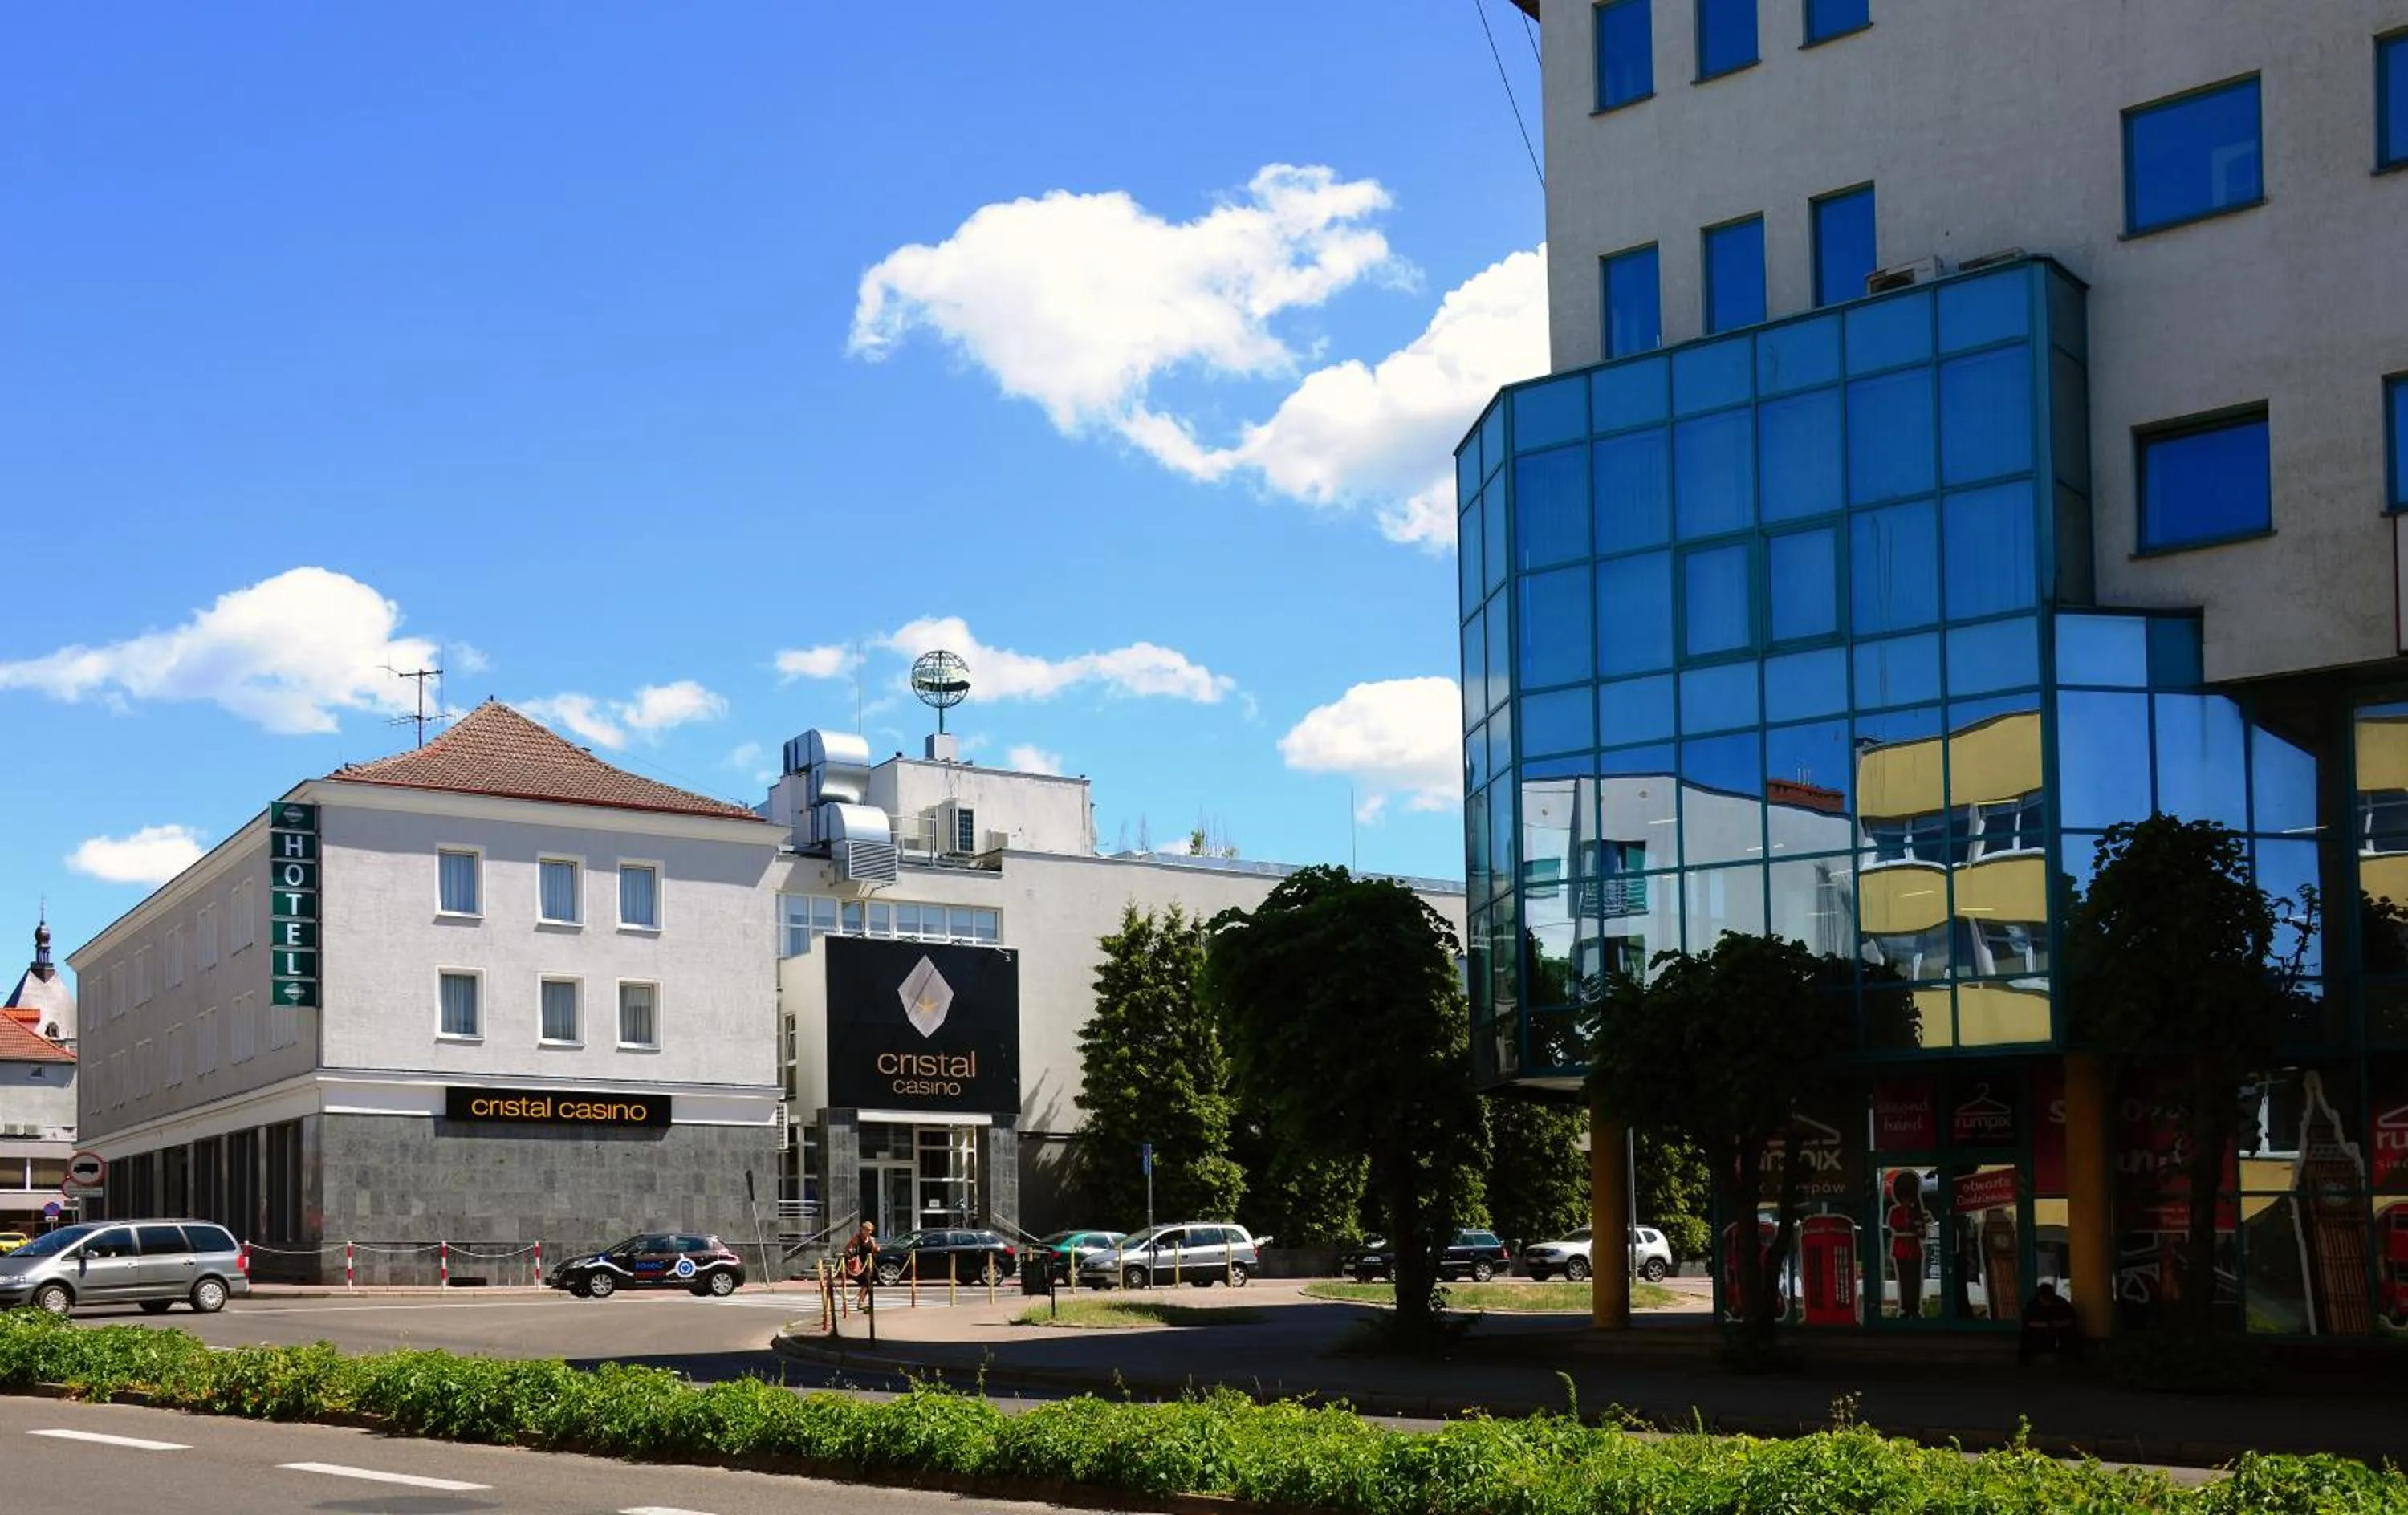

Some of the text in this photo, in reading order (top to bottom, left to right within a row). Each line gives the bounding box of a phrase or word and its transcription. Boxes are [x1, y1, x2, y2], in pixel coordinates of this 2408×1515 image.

[284, 835, 304, 976] HOTEL
[877, 1050, 975, 1078] cristal
[893, 1079, 961, 1095] casino
[471, 1096, 647, 1121] cristal casino
